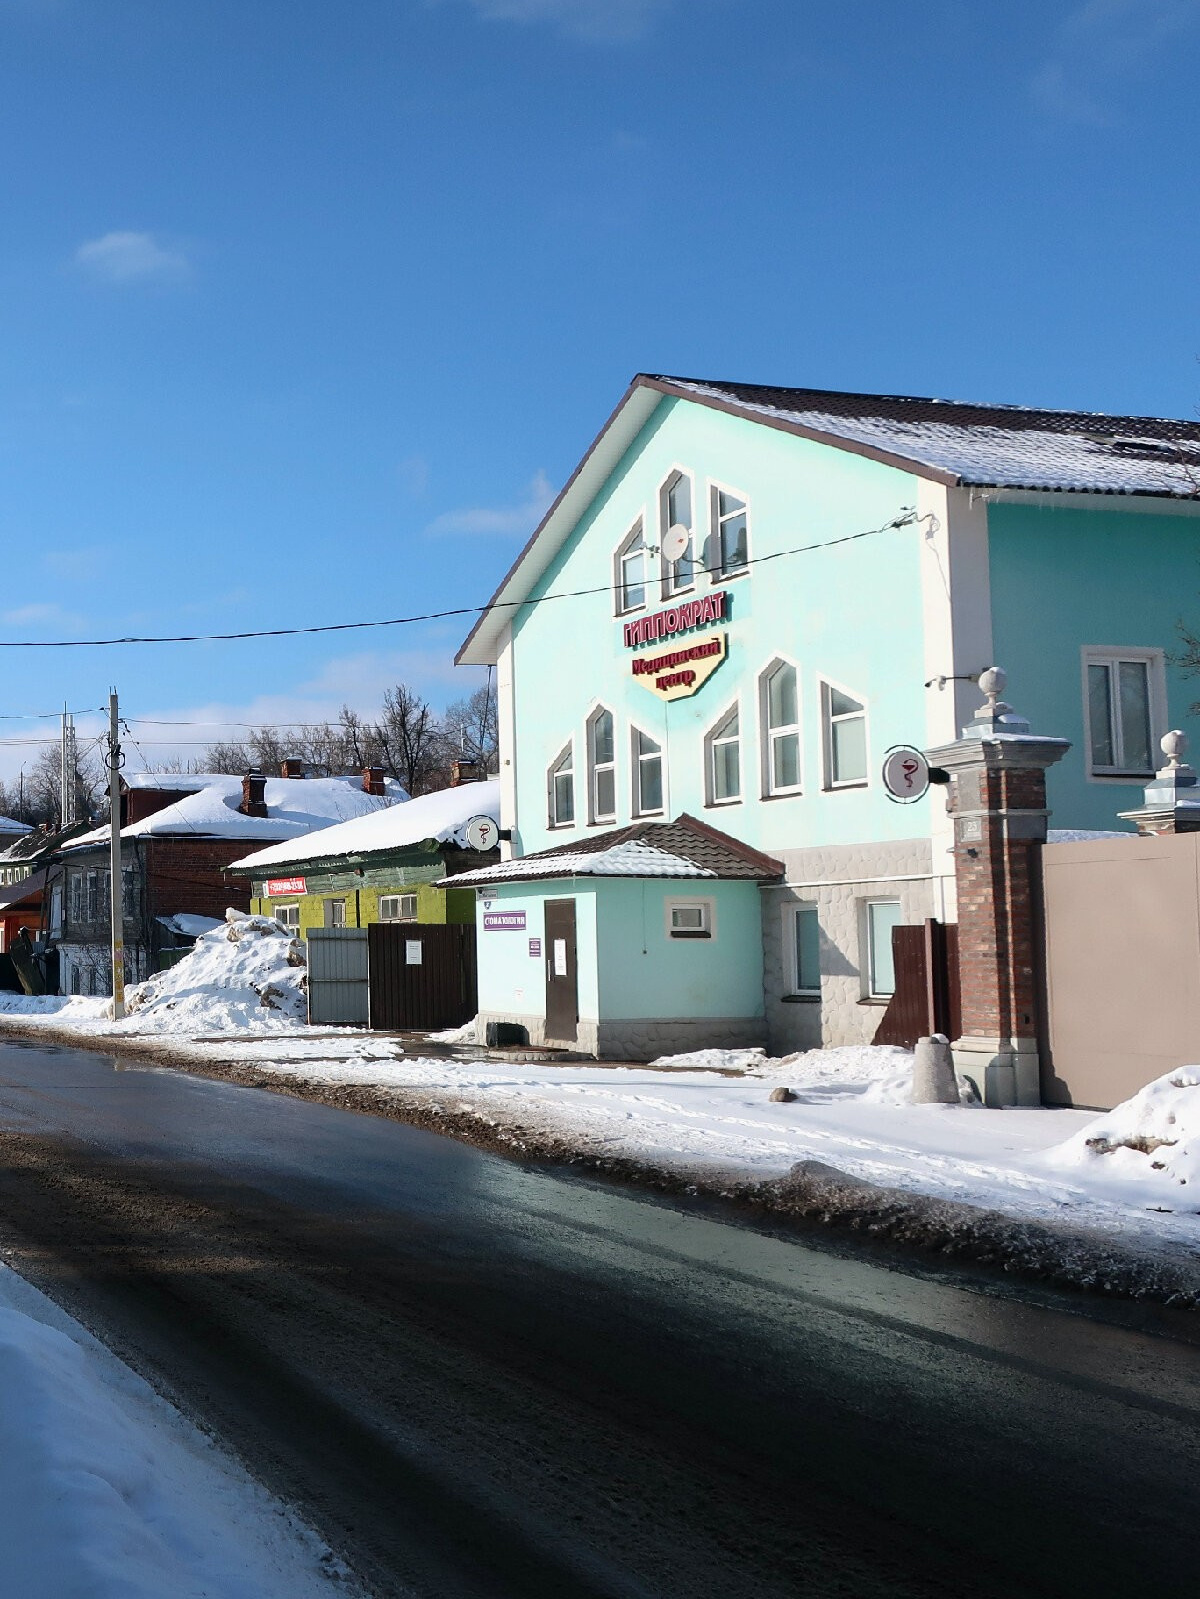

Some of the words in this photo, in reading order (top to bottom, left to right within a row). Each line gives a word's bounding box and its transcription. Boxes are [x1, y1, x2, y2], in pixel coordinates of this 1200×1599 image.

[623, 591, 726, 648] ГИППОКРАТ
[632, 638, 721, 675] Медицинский
[656, 670, 696, 691] центр
